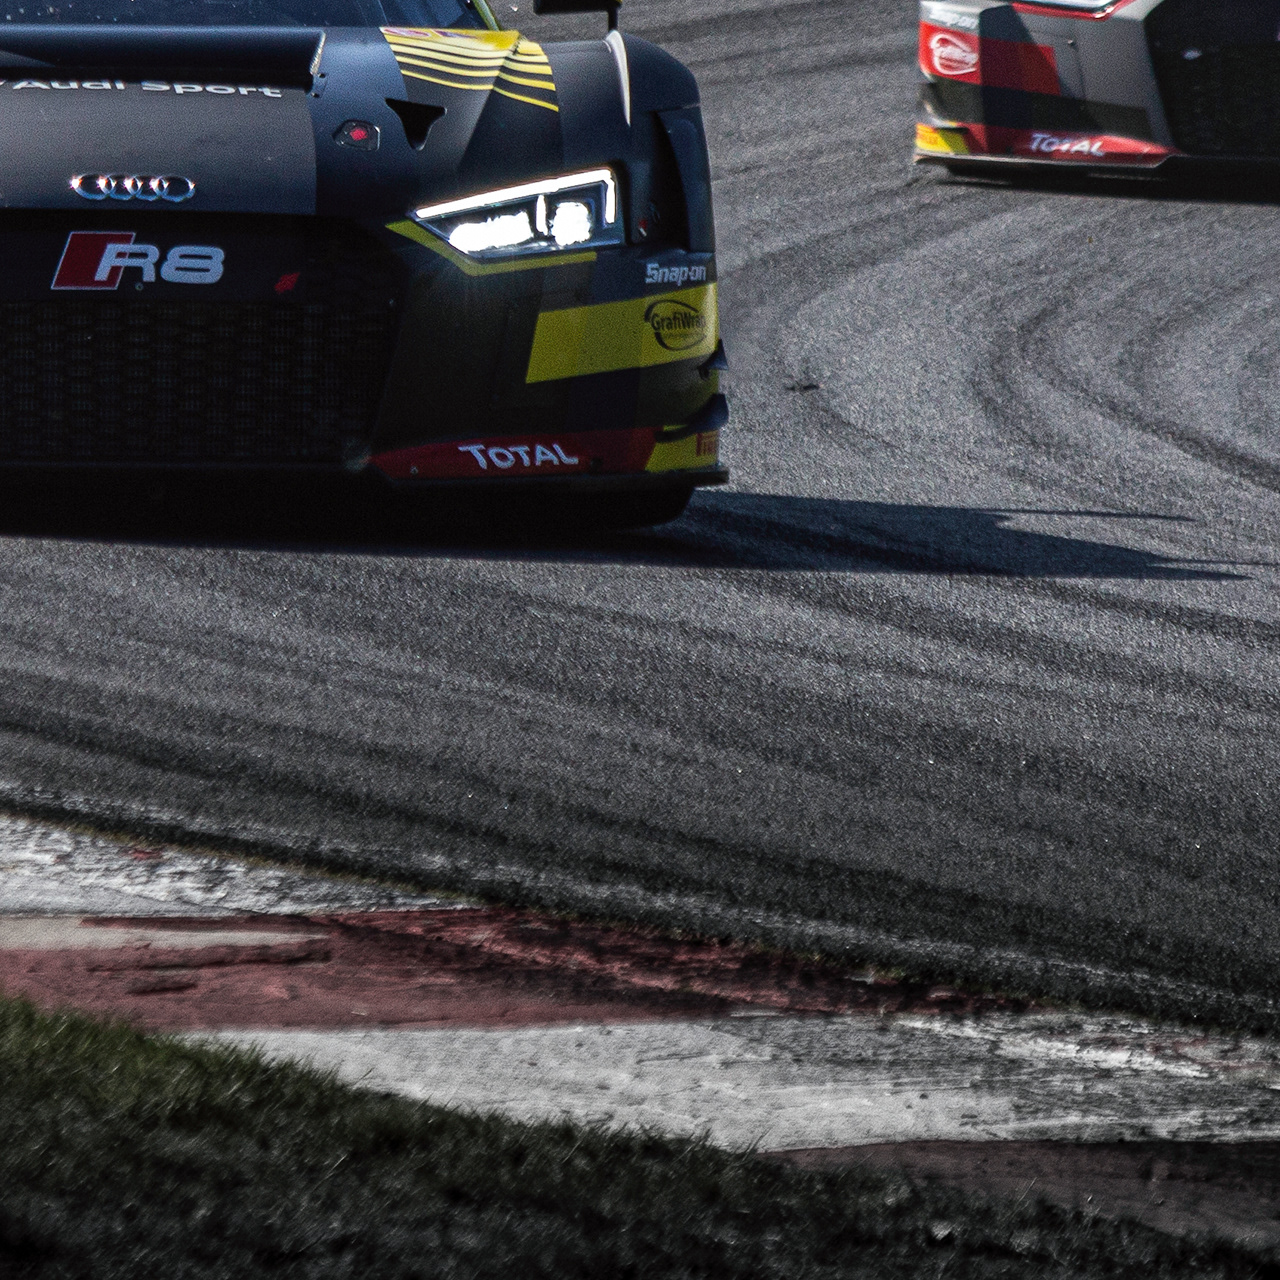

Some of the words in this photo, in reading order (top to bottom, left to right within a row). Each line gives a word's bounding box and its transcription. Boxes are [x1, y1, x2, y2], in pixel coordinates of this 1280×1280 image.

[12, 80, 125, 90] Audi
[141, 80, 283, 98] Sport
[1029, 132, 1106, 157] TOTAL
[93, 243, 225, 284] R8
[458, 443, 579, 470] TOTAL
